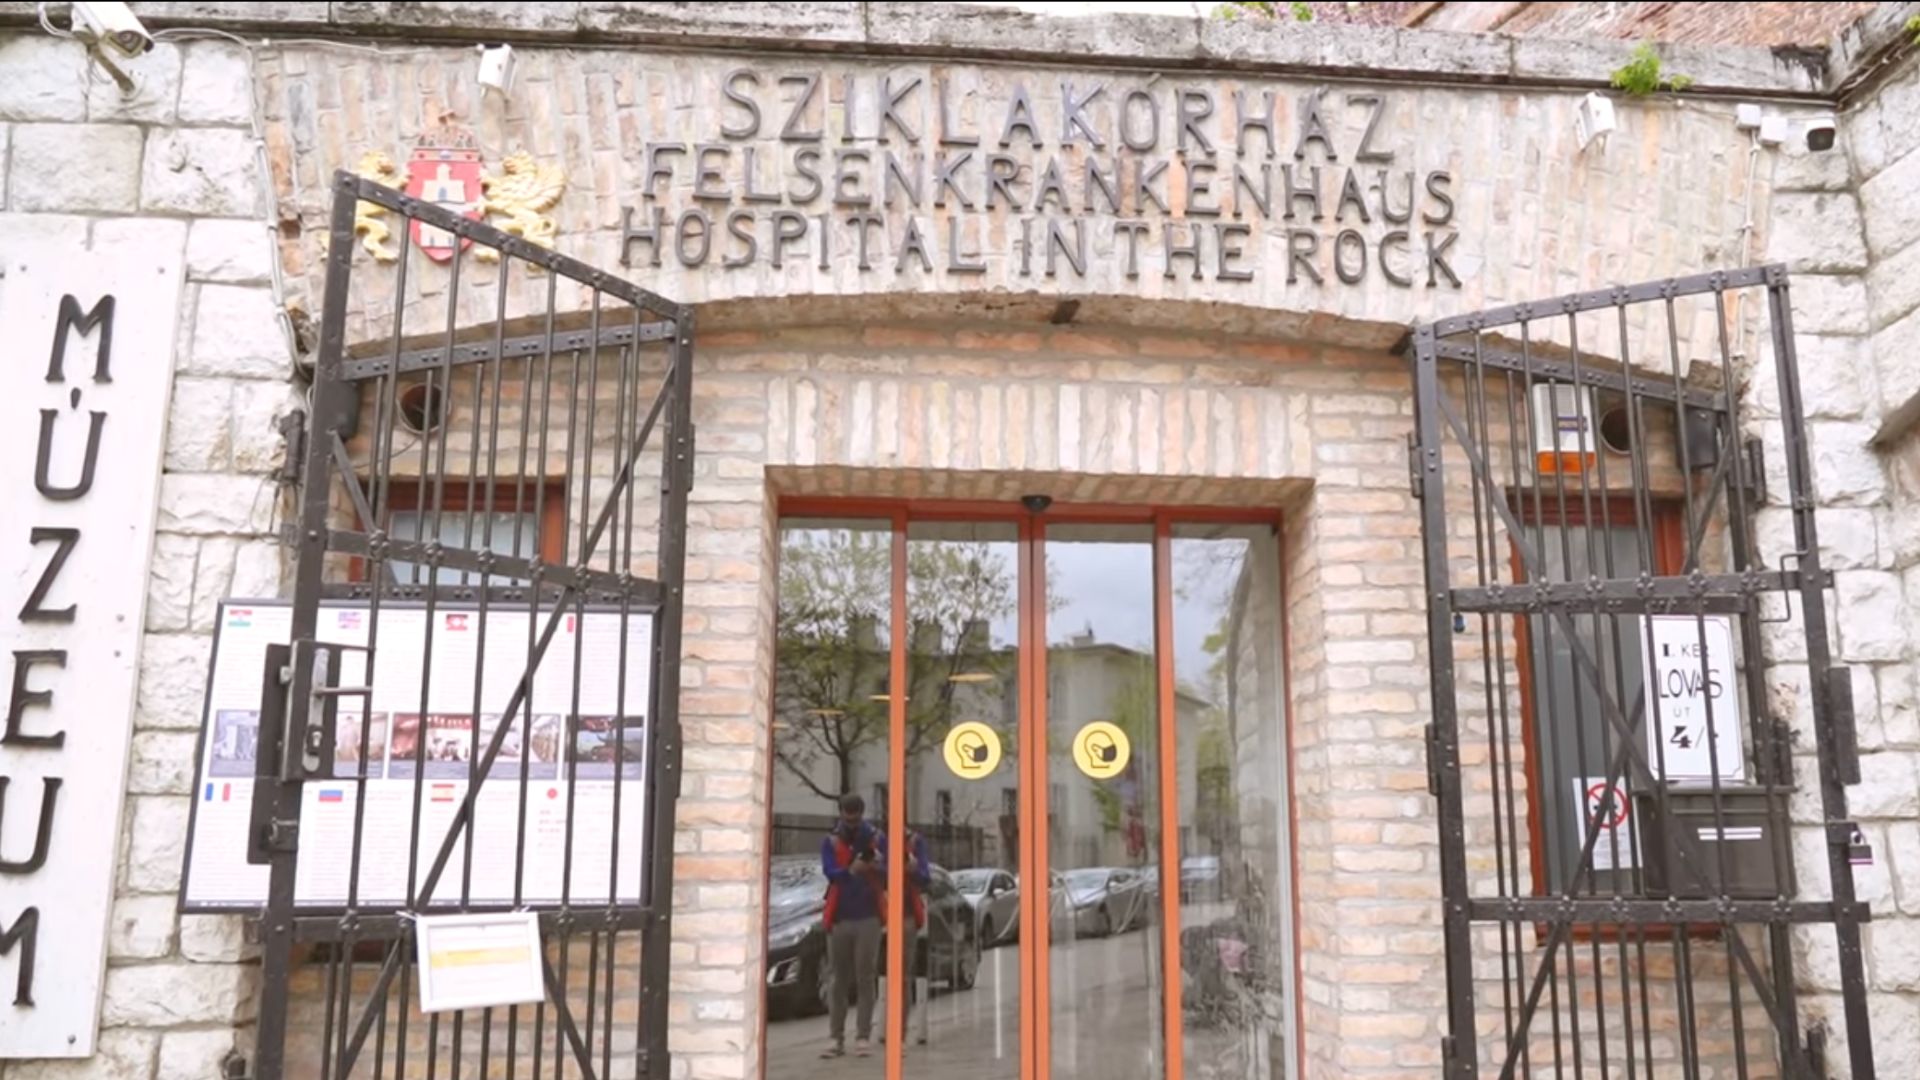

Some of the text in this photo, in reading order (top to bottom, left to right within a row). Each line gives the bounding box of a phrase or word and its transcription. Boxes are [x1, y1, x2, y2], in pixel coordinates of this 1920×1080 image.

[720, 67, 1394, 163] SZIKLAKÓRHÁZ
[642, 142, 1455, 226] FELSENKRANKENHAUS
[618, 205, 1462, 289] HOSPITAL IN THE ROCK
